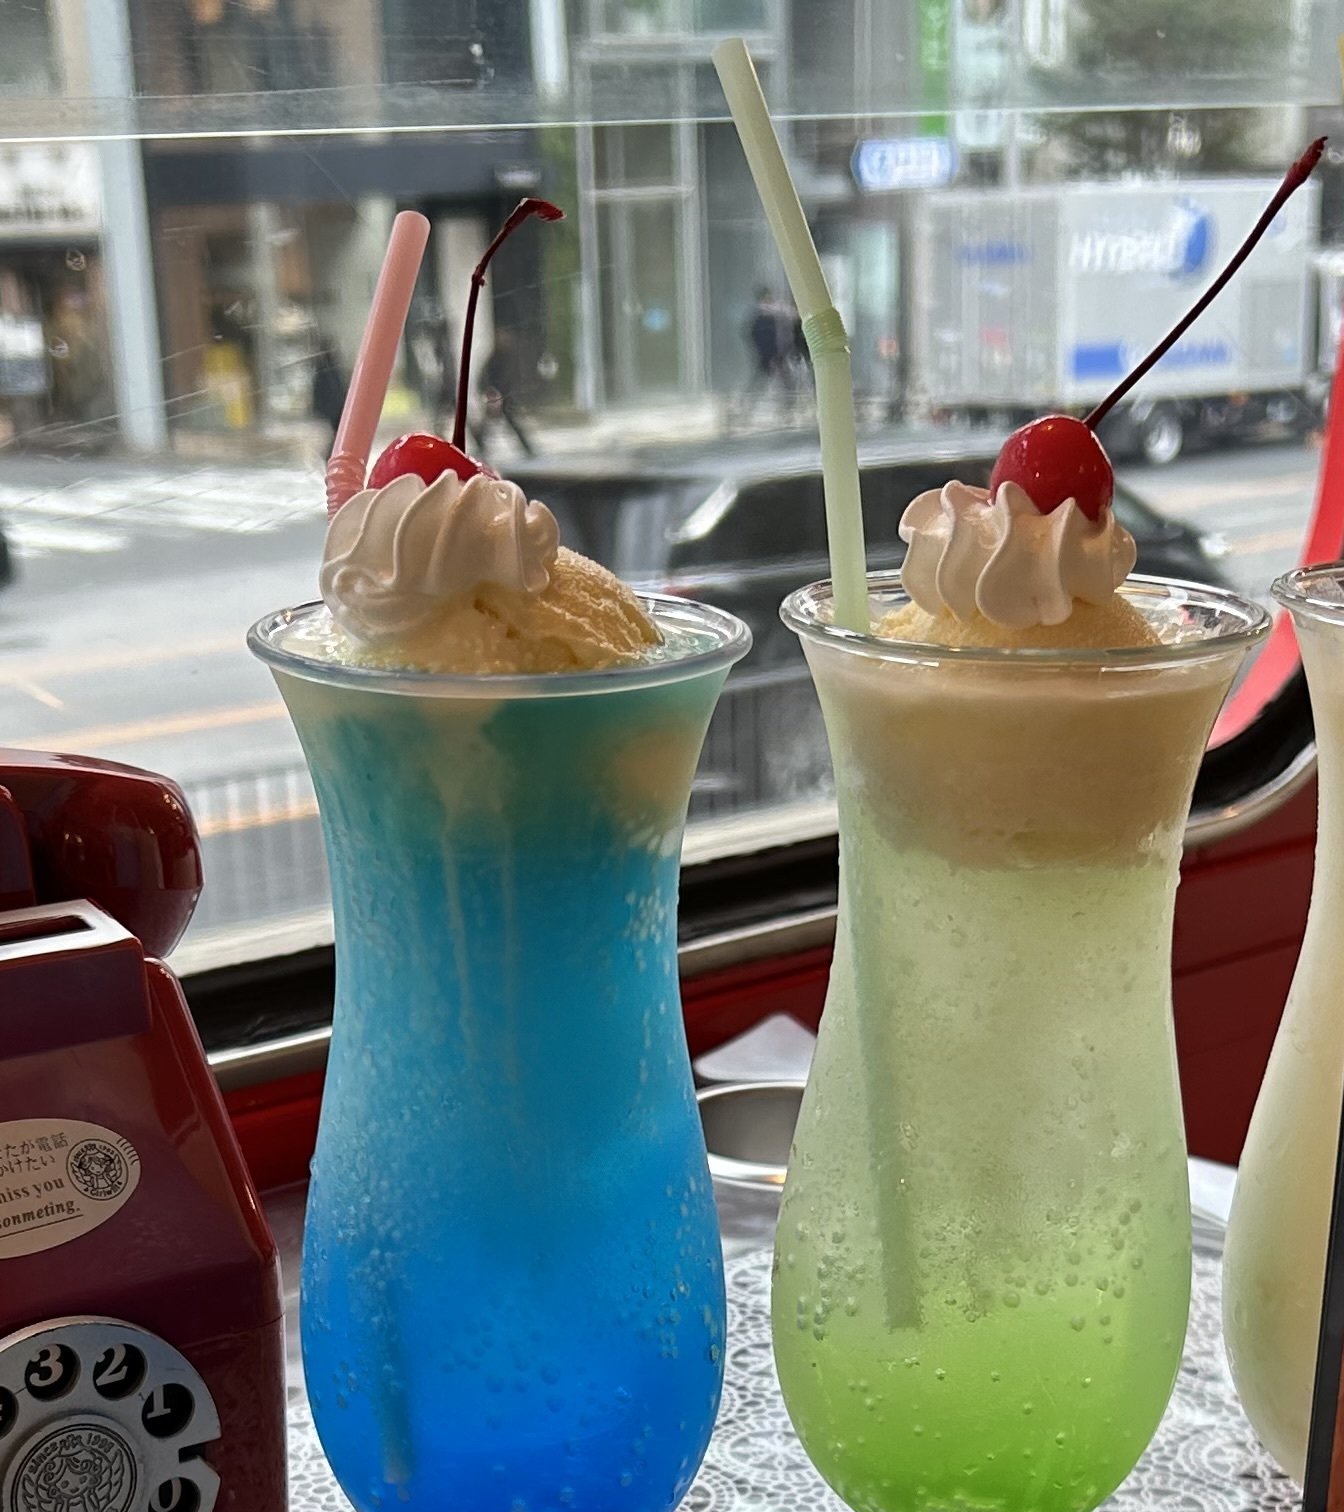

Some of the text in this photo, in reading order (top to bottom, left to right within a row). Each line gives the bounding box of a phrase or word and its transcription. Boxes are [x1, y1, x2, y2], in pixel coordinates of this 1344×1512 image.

[33, 1177, 65, 1200] you
[29, 1343, 65, 1388] 3
[96, 1343, 129, 1387] 2
[147, 1384, 172, 1419] 1
